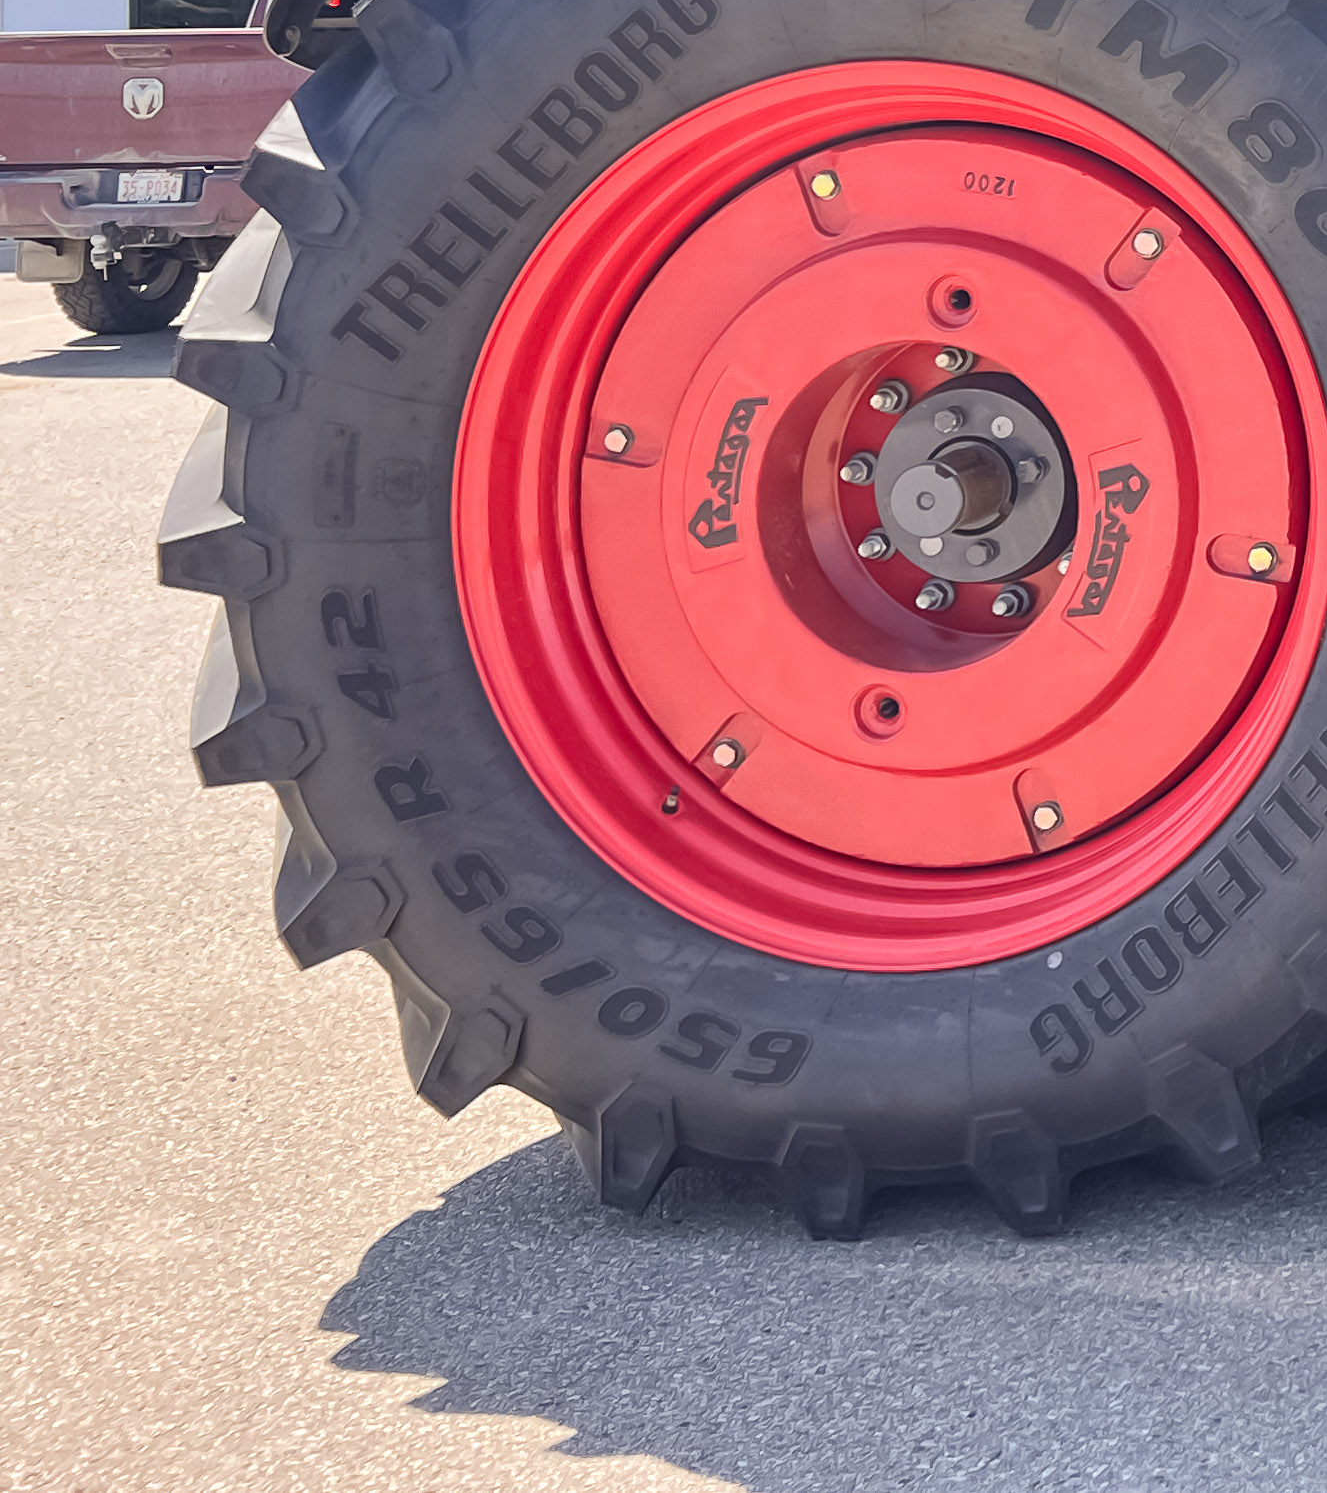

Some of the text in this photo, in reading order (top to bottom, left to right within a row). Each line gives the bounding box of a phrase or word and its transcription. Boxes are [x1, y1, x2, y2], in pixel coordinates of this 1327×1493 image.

[965, 170, 1016, 196] 1200
[320, 586, 397, 720] 42
[374, 755, 450, 823] R
